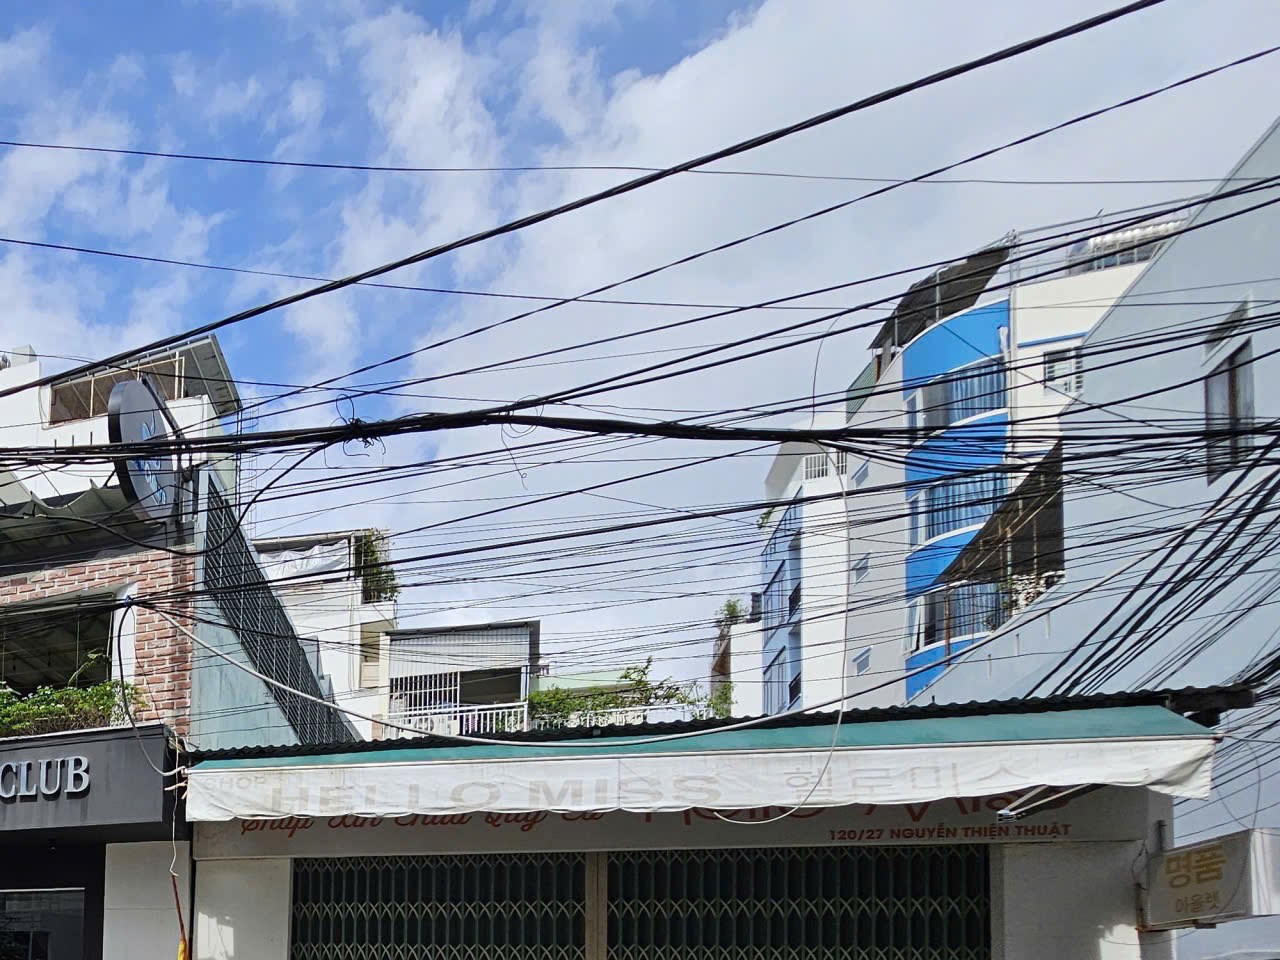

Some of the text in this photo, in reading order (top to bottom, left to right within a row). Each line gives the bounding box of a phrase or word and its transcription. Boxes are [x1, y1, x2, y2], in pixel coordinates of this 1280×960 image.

[528, 774, 721, 807] MISS
[829, 822, 1072, 842] 120/27 NGUYỄN THIỆN THUẬT
[1165, 843, 1227, 888] 명품
